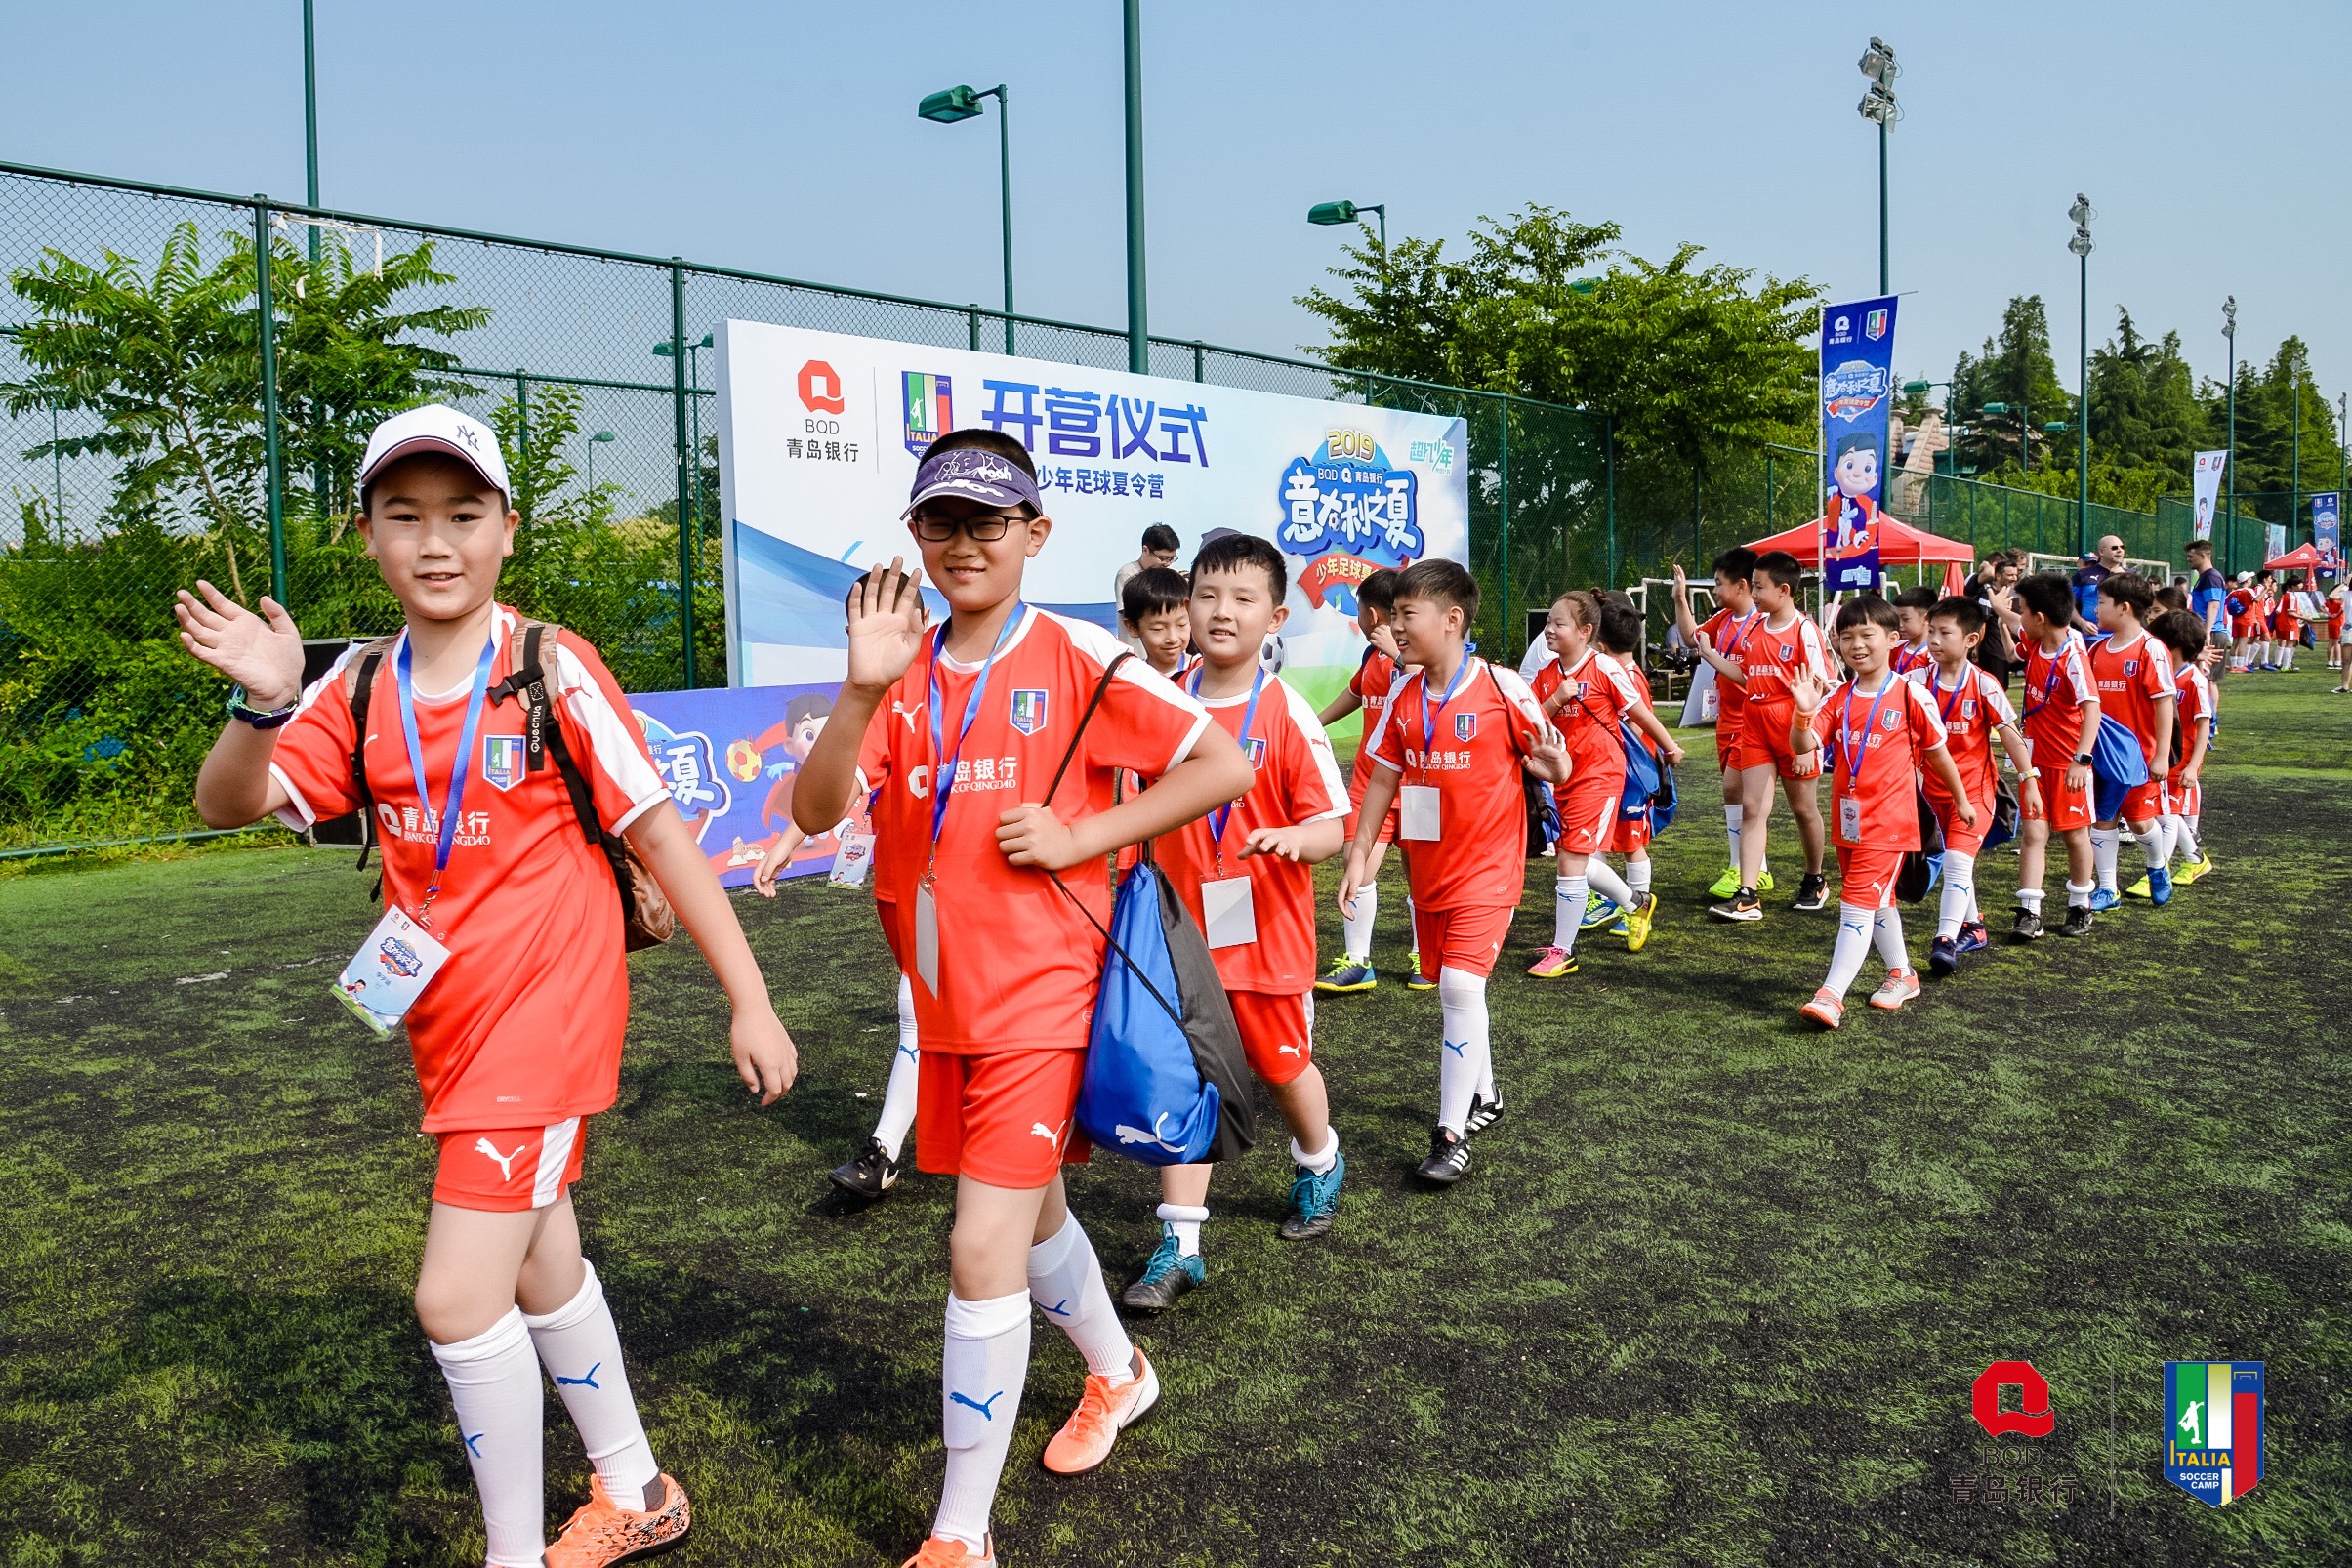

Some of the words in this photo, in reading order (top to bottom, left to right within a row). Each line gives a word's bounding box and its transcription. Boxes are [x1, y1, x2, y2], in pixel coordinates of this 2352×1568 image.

[805, 419, 840, 434] BQD
[981, 378, 1209, 468] 开营仪式
[786, 438, 859, 463] 青岛银行
[1328, 430, 1375, 461] 2019
[1037, 465, 1164, 499] 少年足球夏令营
[1318, 468, 1338, 481] BQD
[1354, 471, 1382, 485] 青岛银行
[1283, 466, 1417, 550] 意大利之夏
[529, 706, 542, 753] Quechua
[937, 757, 1017, 783] 岛银行
[970, 779, 1016, 791] QINGDAO
[404, 831, 426, 844] BANK
